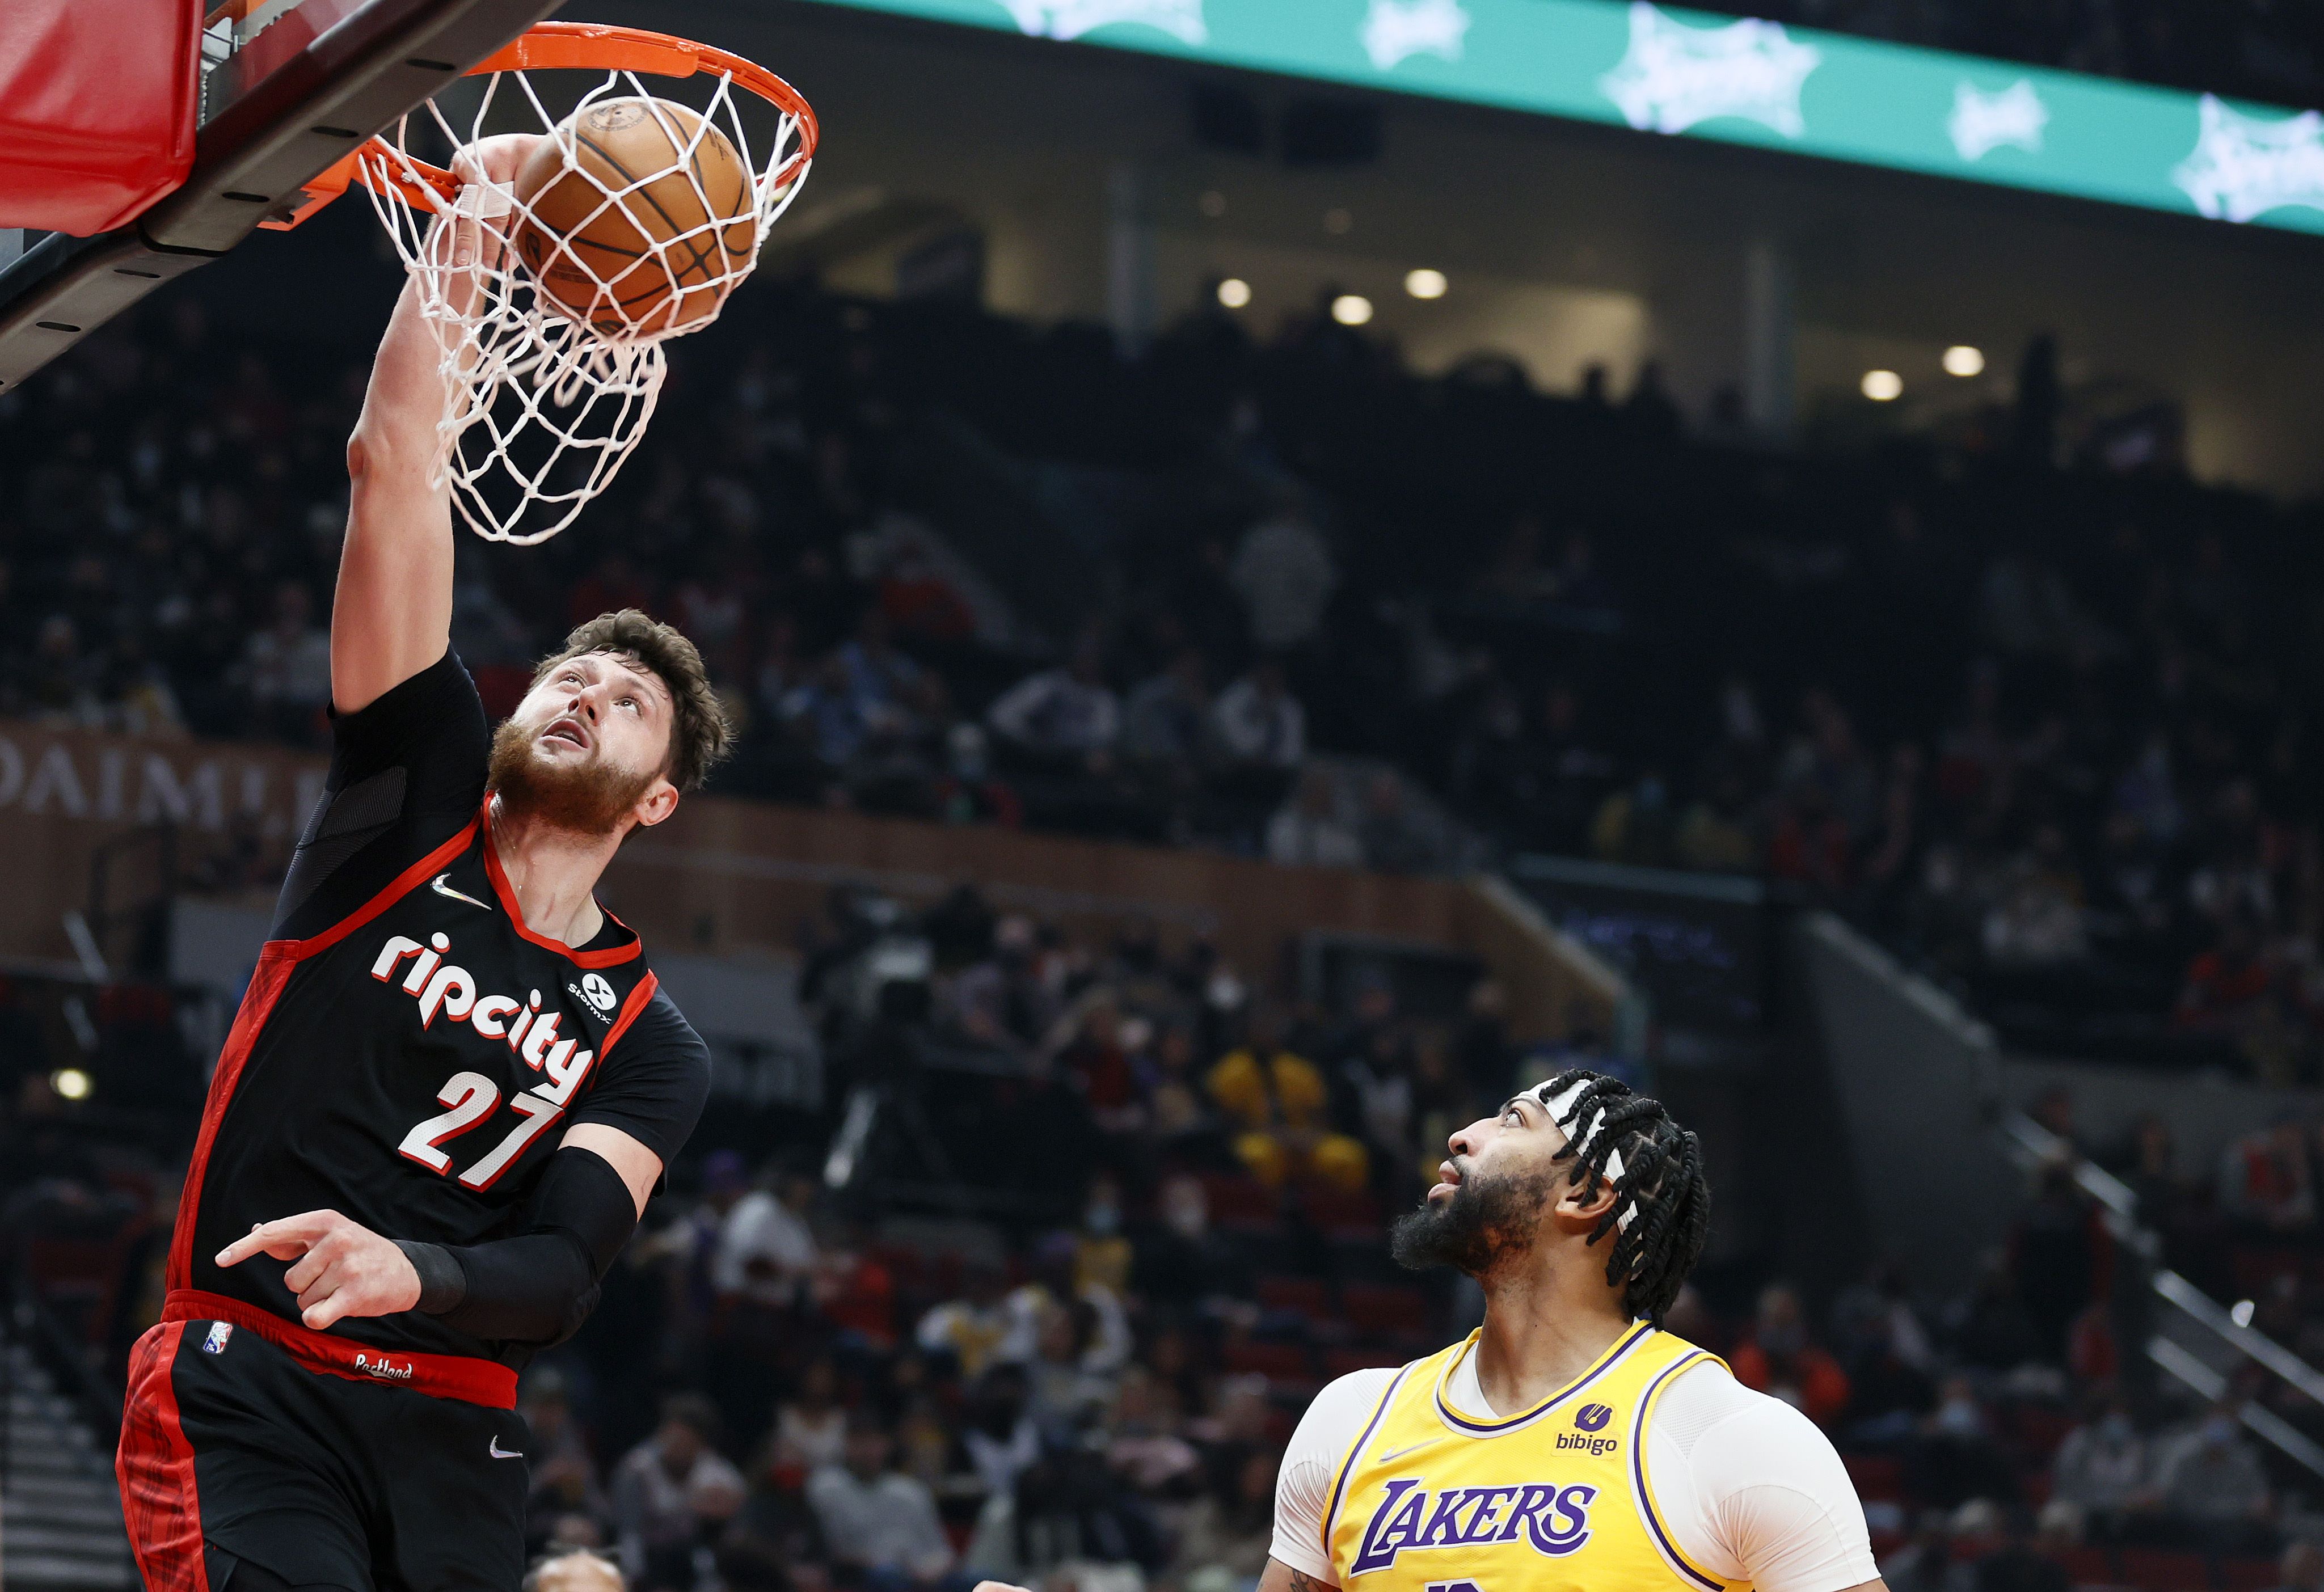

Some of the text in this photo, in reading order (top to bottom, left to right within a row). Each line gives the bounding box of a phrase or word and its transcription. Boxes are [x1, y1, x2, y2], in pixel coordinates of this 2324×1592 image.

[371, 932, 594, 1109] ripcity
[398, 1071, 565, 1193] 27
[355, 1354, 412, 1379] Portland
[1556, 1433, 1617, 1456] bibigo
